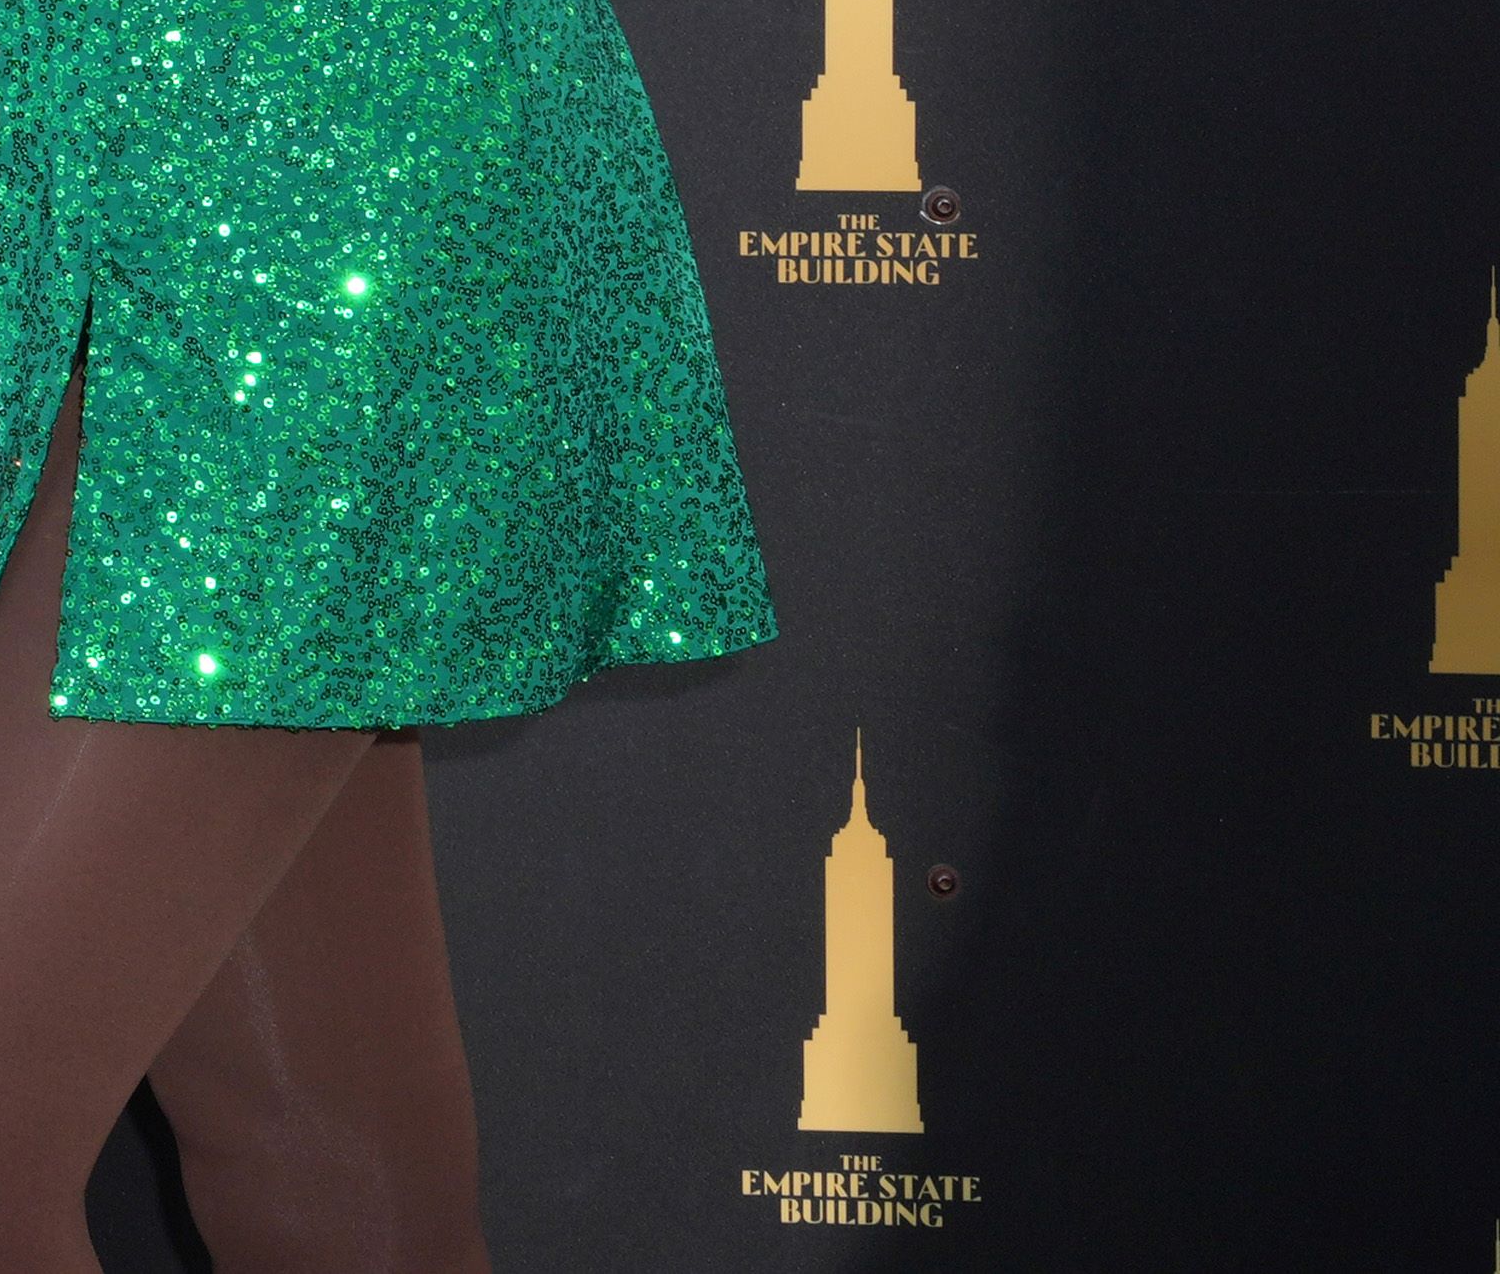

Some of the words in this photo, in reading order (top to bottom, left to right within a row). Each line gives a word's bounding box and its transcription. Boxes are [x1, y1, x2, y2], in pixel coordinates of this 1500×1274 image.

[837, 214, 880, 230] THE
[739, 231, 866, 257] EMPIRE
[876, 233, 978, 259] STATE
[777, 258, 940, 285] BUILDING
[1472, 698, 1500, 714] TH
[1370, 714, 1500, 742] EMPIRE
[1410, 741, 1500, 769] BUIL
[840, 1154, 883, 1172] THE
[741, 1169, 869, 1199] EMPIRE
[879, 1174, 982, 1202] STATE
[780, 1198, 943, 1228] BUILDING
